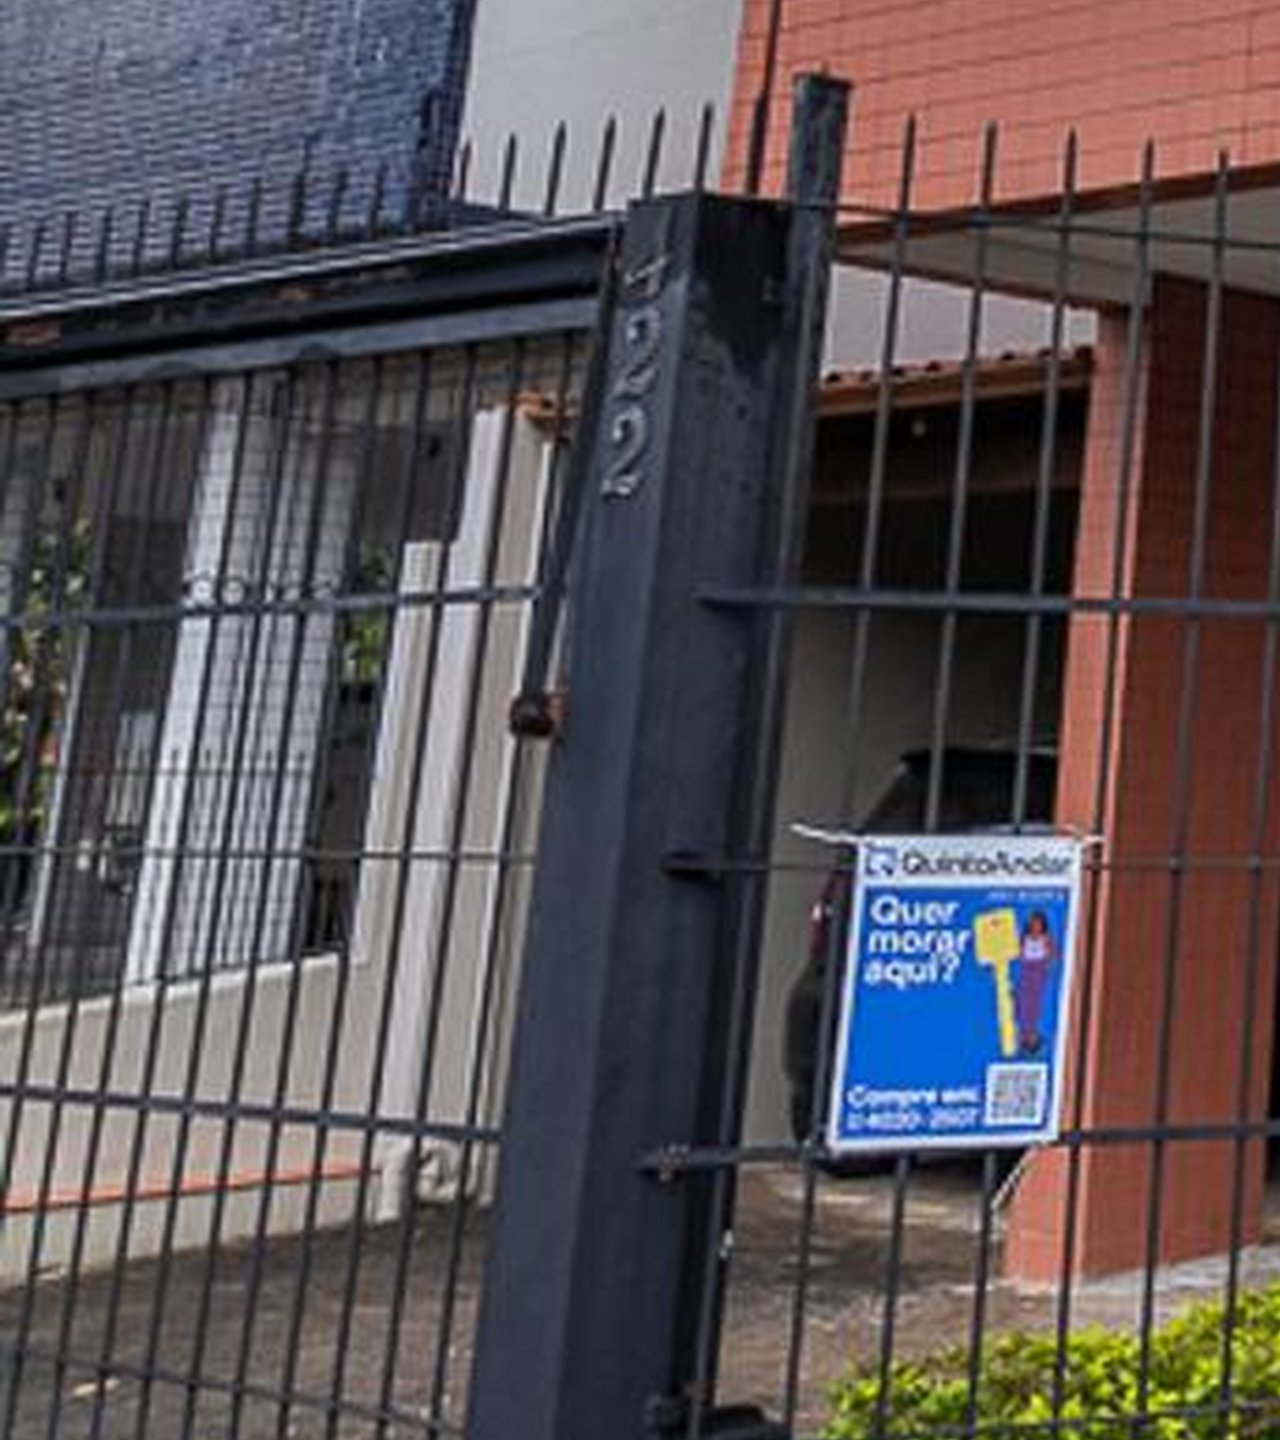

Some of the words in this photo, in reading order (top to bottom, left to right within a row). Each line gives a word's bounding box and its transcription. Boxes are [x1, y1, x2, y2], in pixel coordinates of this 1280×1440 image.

[902, 851, 1072, 875] QuintoAndar
[869, 895, 959, 926] Quer
[867, 929, 971, 955] morar
[863, 952, 960, 988] aqui?
